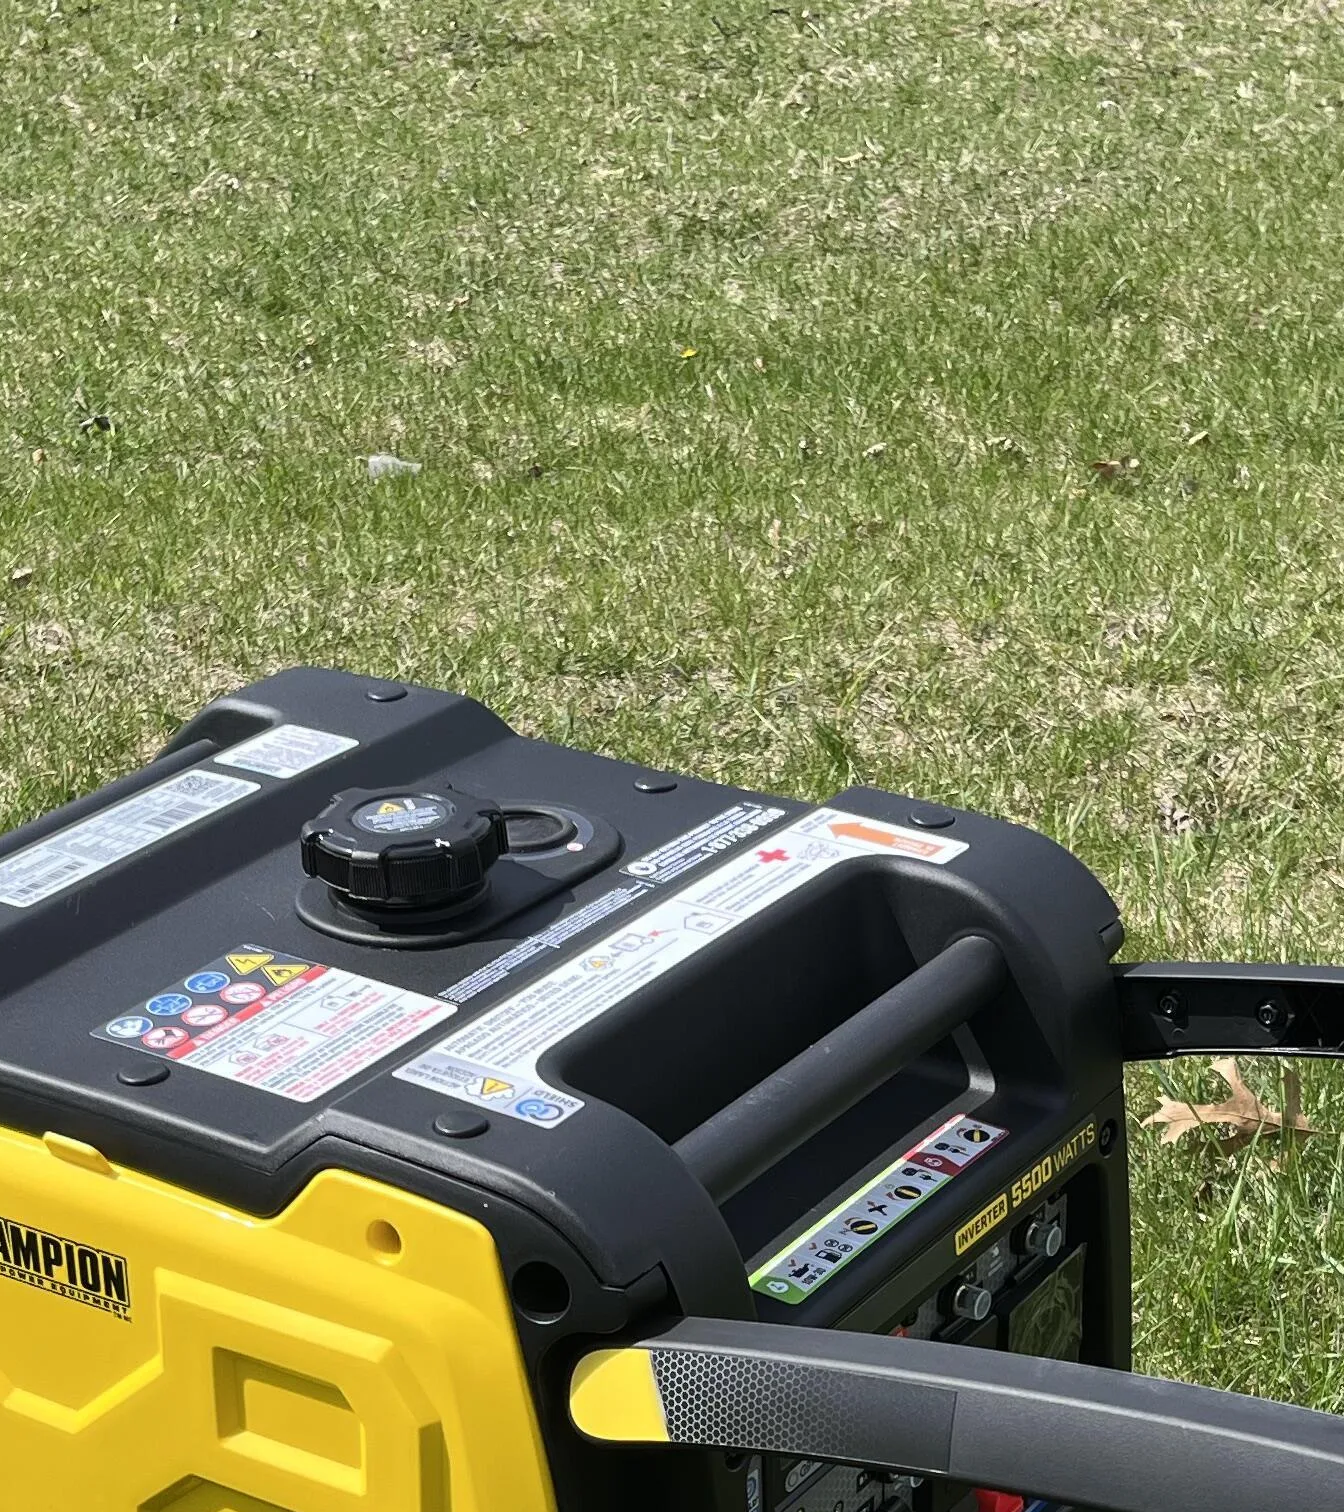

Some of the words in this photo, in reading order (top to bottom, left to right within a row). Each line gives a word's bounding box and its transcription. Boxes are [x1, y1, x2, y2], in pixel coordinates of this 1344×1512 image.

[957, 1201, 1006, 1249] INVERTER
[1011, 1155, 1053, 1208] 5500
[1053, 1122, 1096, 1172] WATTS
[0, 1264, 45, 1287] POWER
[51, 1281, 129, 1315] EQUIPMENT
